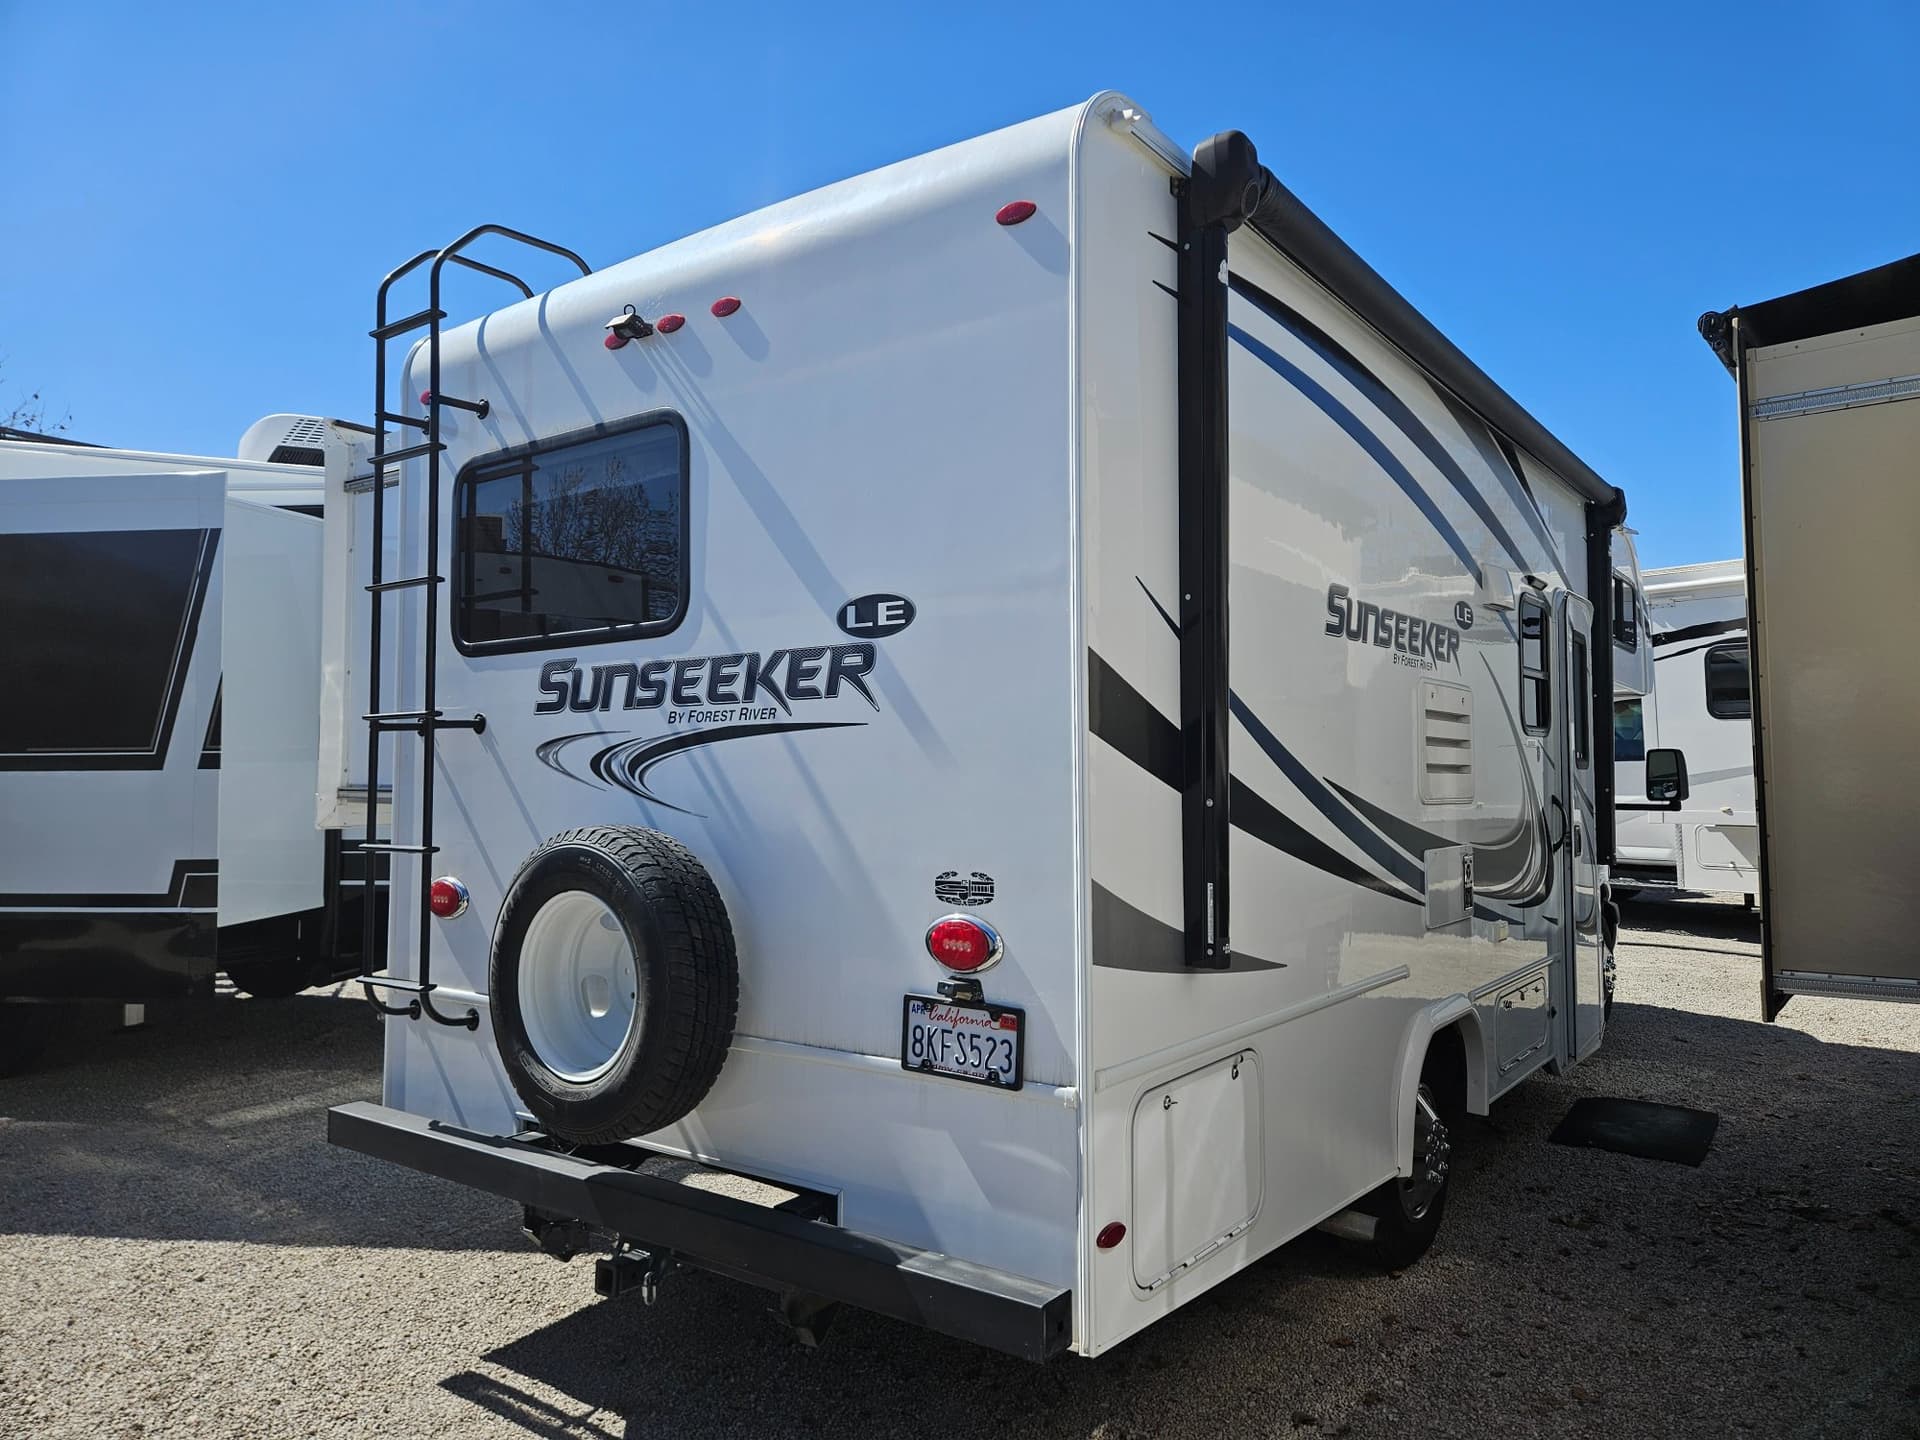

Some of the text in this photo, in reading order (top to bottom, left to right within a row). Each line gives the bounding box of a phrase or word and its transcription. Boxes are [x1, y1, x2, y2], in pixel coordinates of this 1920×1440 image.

[845, 600, 907, 629] LE
[1456, 604, 1473, 624] LE
[1393, 653, 1401, 665] BY
[1401, 655, 1419, 669] FOREST
[668, 706, 776, 724] BY FOREST RIVER
[911, 1003, 926, 1015] APR
[929, 1004, 1000, 1030] California
[912, 1025, 1013, 1074] 8KFS523
